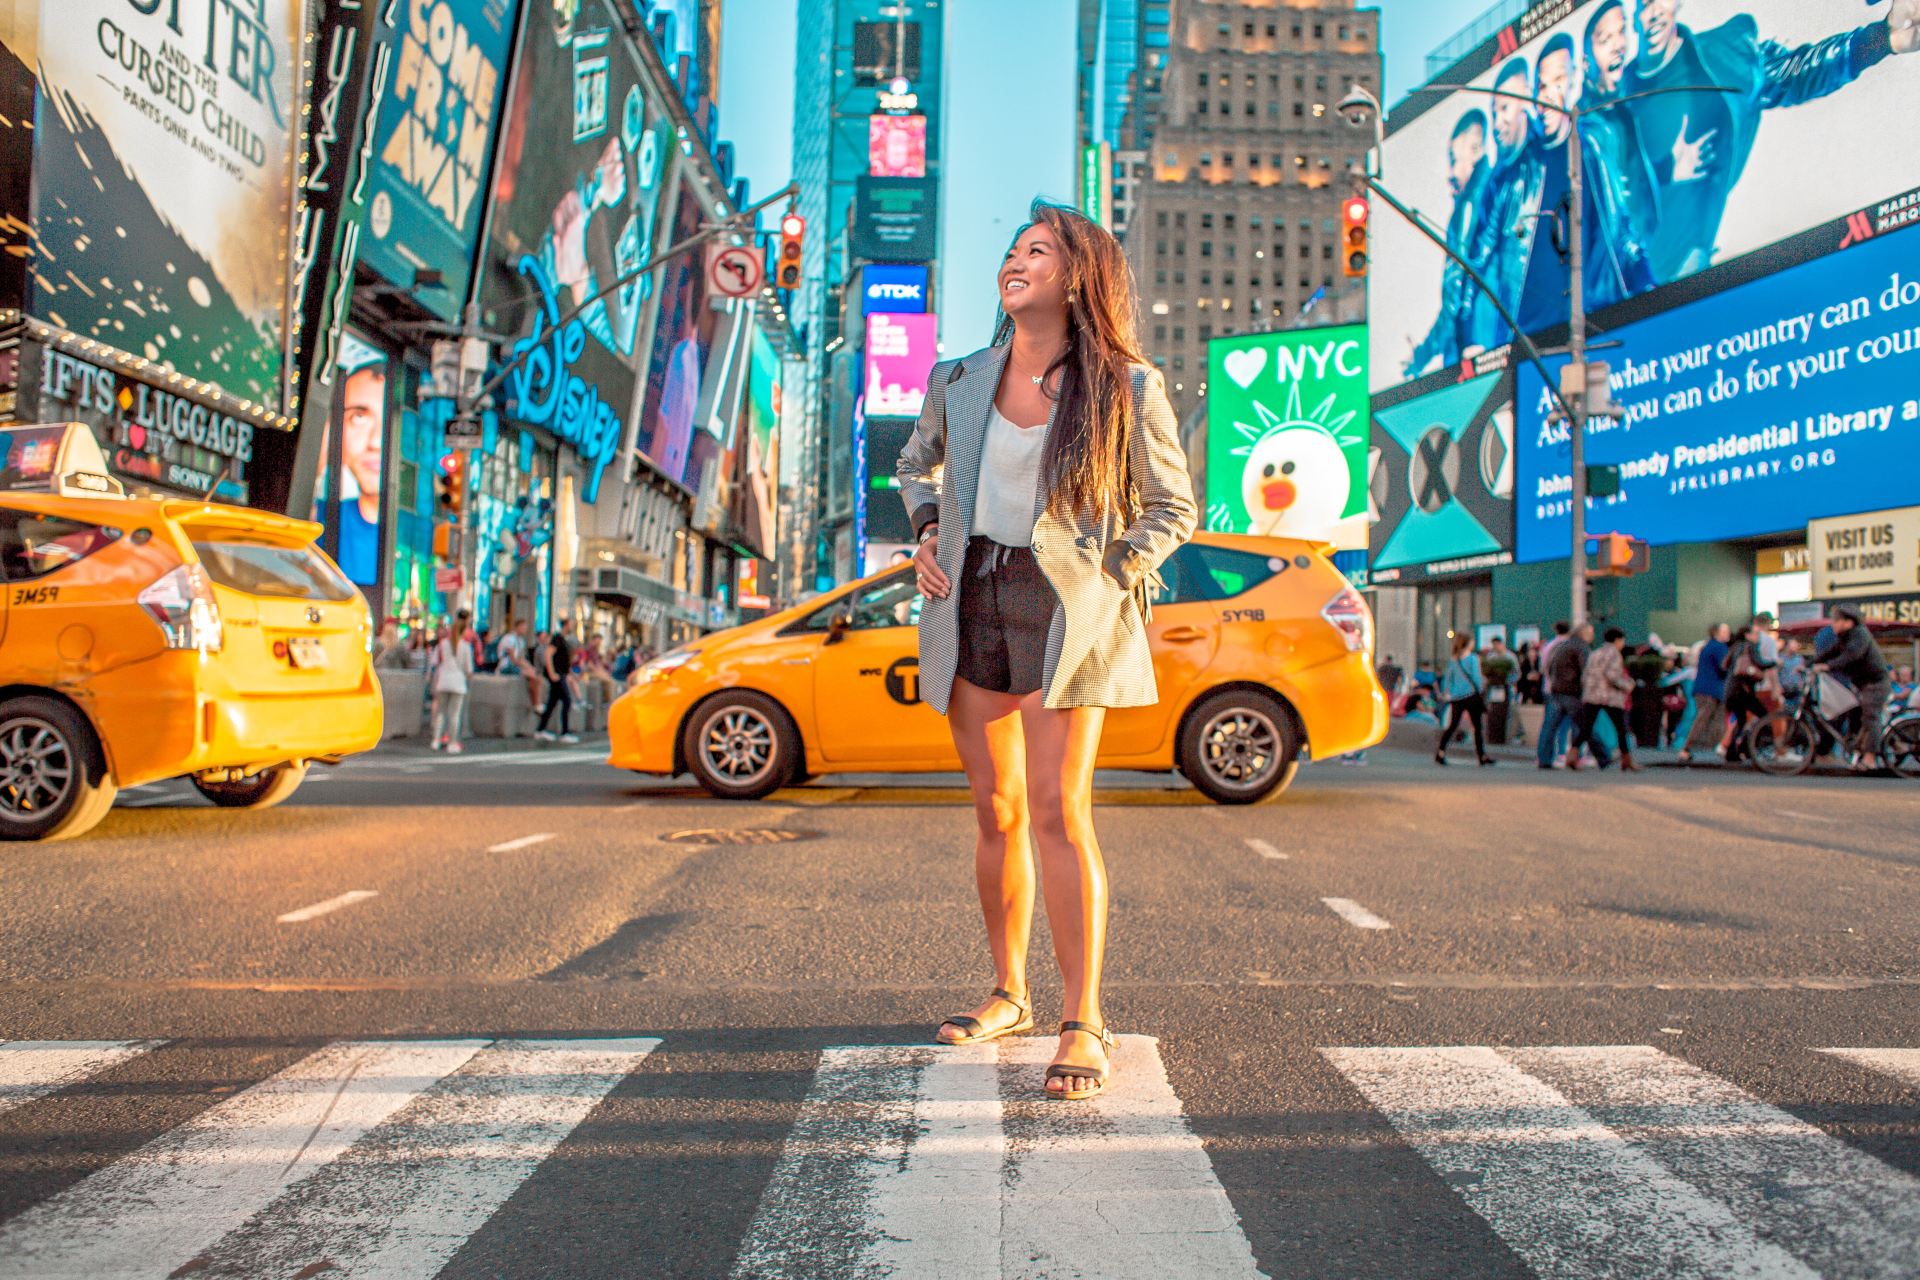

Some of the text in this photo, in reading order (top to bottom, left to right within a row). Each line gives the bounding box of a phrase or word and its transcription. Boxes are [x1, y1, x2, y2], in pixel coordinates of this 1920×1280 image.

[1520, 0, 1573, 46] MARQUIS
[158, 40, 218, 98] AND THE
[98, 18, 266, 168] CURSED CHILD
[123, 86, 244, 182] PARTS ONE AND TWO
[381, 109, 479, 232] AWAY
[881, 283, 921, 298] TDK
[1610, 272, 1920, 391] what your country can do
[1277, 339, 1363, 383] NYC
[1623, 397, 1659, 432] you
[1664, 386, 1702, 414] can
[1707, 368, 1740, 403] do
[1746, 358, 1783, 393] for
[1787, 345, 1850, 390] your
[120, 419, 131, 447] I
[136, 384, 254, 463] LUGGAGE
[1536, 473, 1573, 498] John
[1673, 420, 1799, 470] Presidential
[1805, 404, 1894, 442] Library
[1668, 447, 1837, 496] JFKLIBRARY.ORG
[168, 463, 212, 493] SONY
[1826, 523, 1895, 551] VISIT US
[1826, 551, 1895, 572] NEXT DOOR
[13, 585, 60, 606] 3M59
[859, 667, 883, 677] NYC
